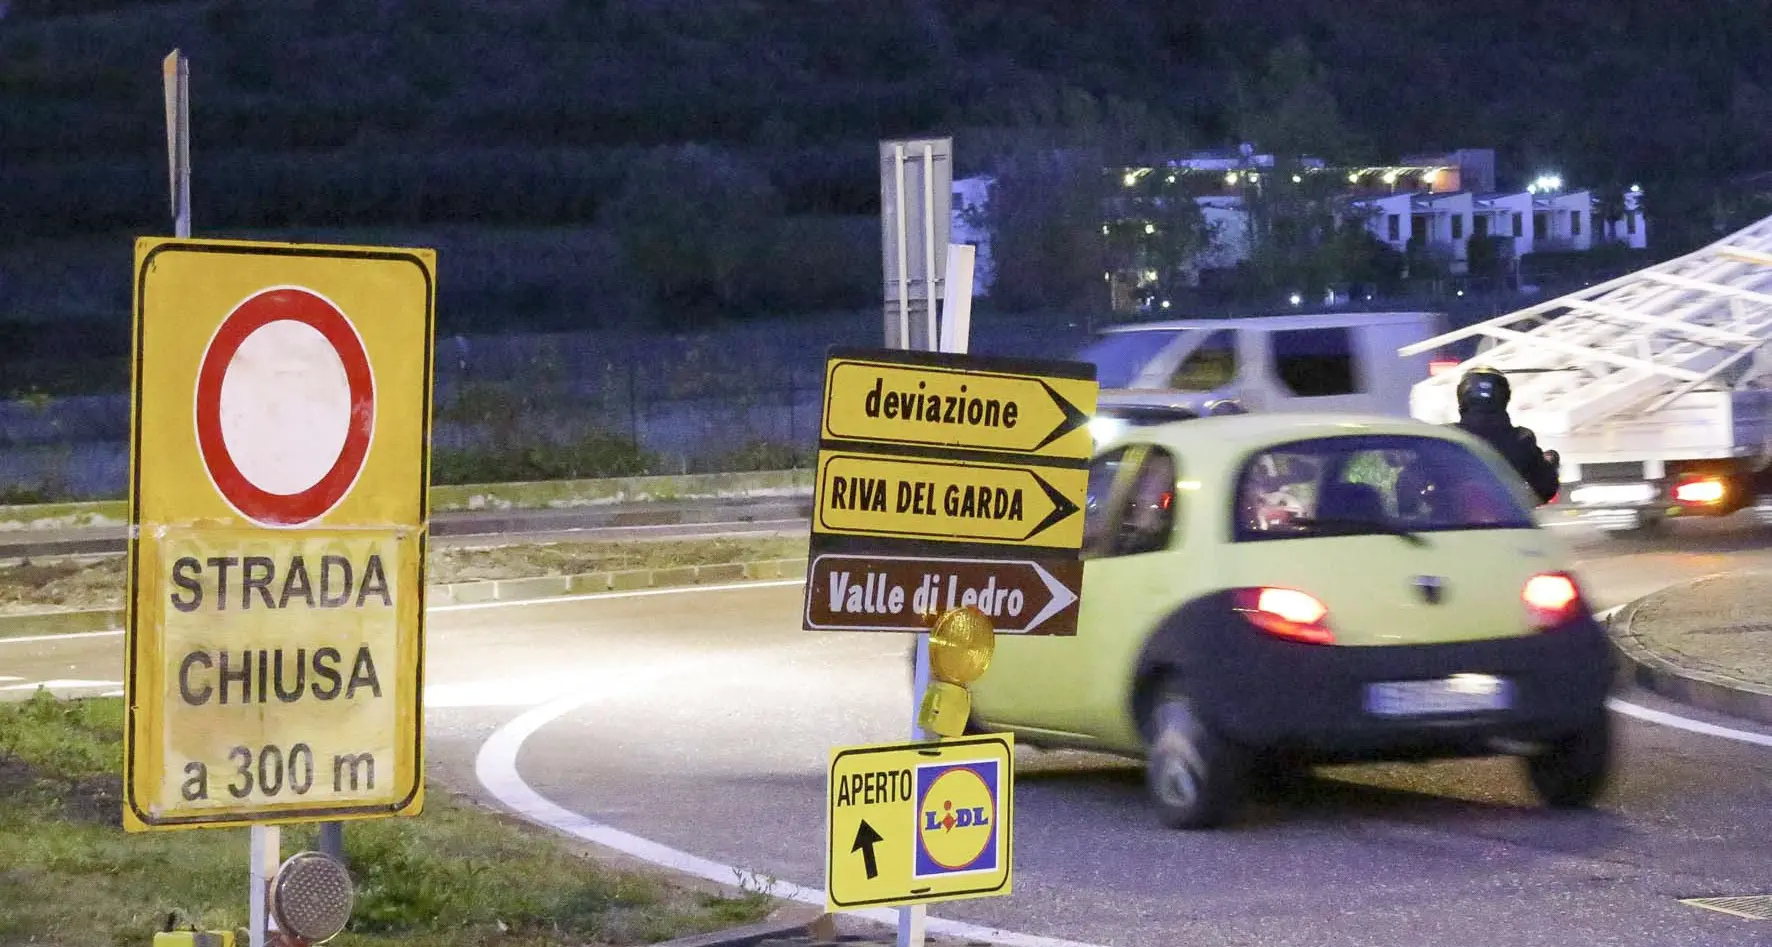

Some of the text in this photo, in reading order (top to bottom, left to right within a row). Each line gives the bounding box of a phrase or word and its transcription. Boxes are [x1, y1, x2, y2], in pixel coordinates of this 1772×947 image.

[865, 378, 1018, 428] deviazione
[831, 476, 1023, 521] RIVA DEL GARDA
[170, 554, 392, 612] STRADA
[829, 571, 904, 614] Valle
[912, 574, 940, 615] di
[178, 646, 382, 705] CHIUSA
[181, 743, 375, 800] a 300 m
[837, 769, 912, 807] APERTO
